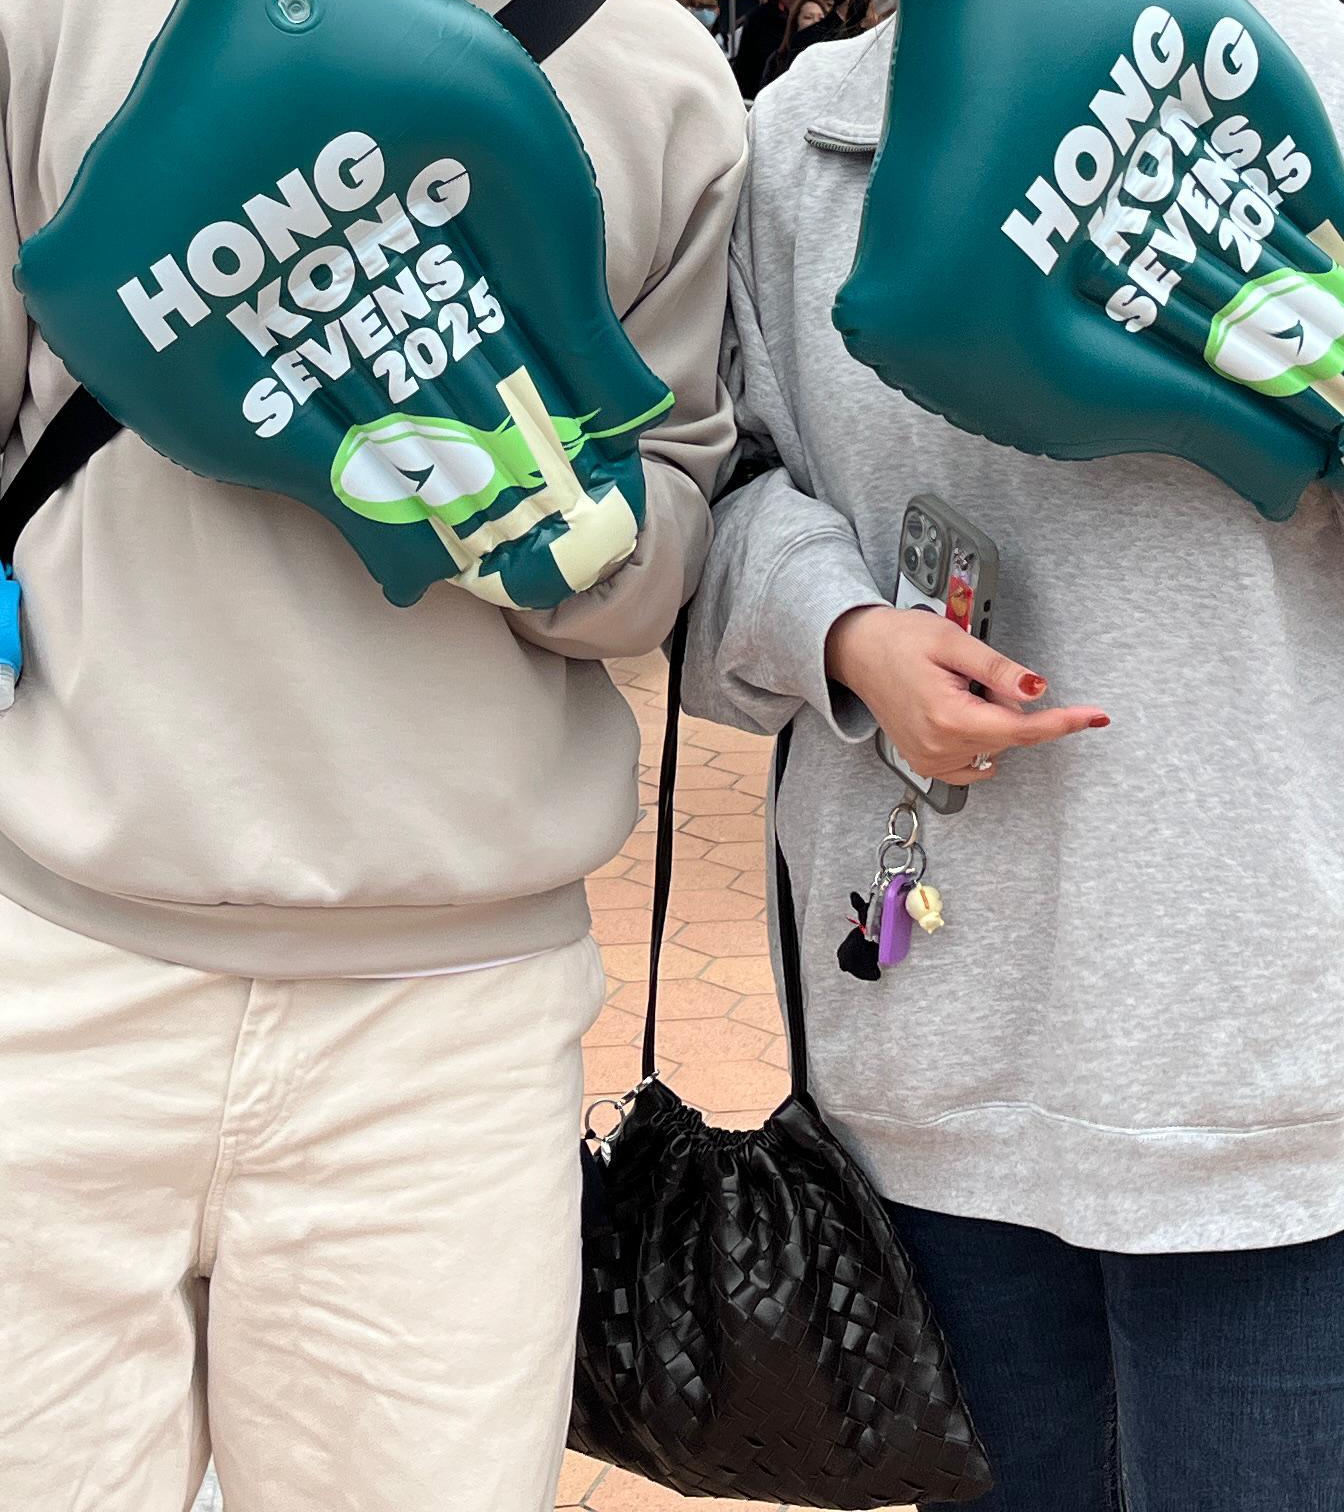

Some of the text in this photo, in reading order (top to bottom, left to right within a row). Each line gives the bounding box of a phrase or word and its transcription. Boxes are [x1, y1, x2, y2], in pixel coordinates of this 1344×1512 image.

[116, 131, 385, 352] HONG
[1001, 5, 1184, 275] HONG
[1088, 16, 1259, 265] KONG
[1105, 114, 1262, 333] SEVENS
[226, 157, 471, 357] KONG
[242, 243, 464, 438] SEVENS
[373, 278, 505, 404] 2025
